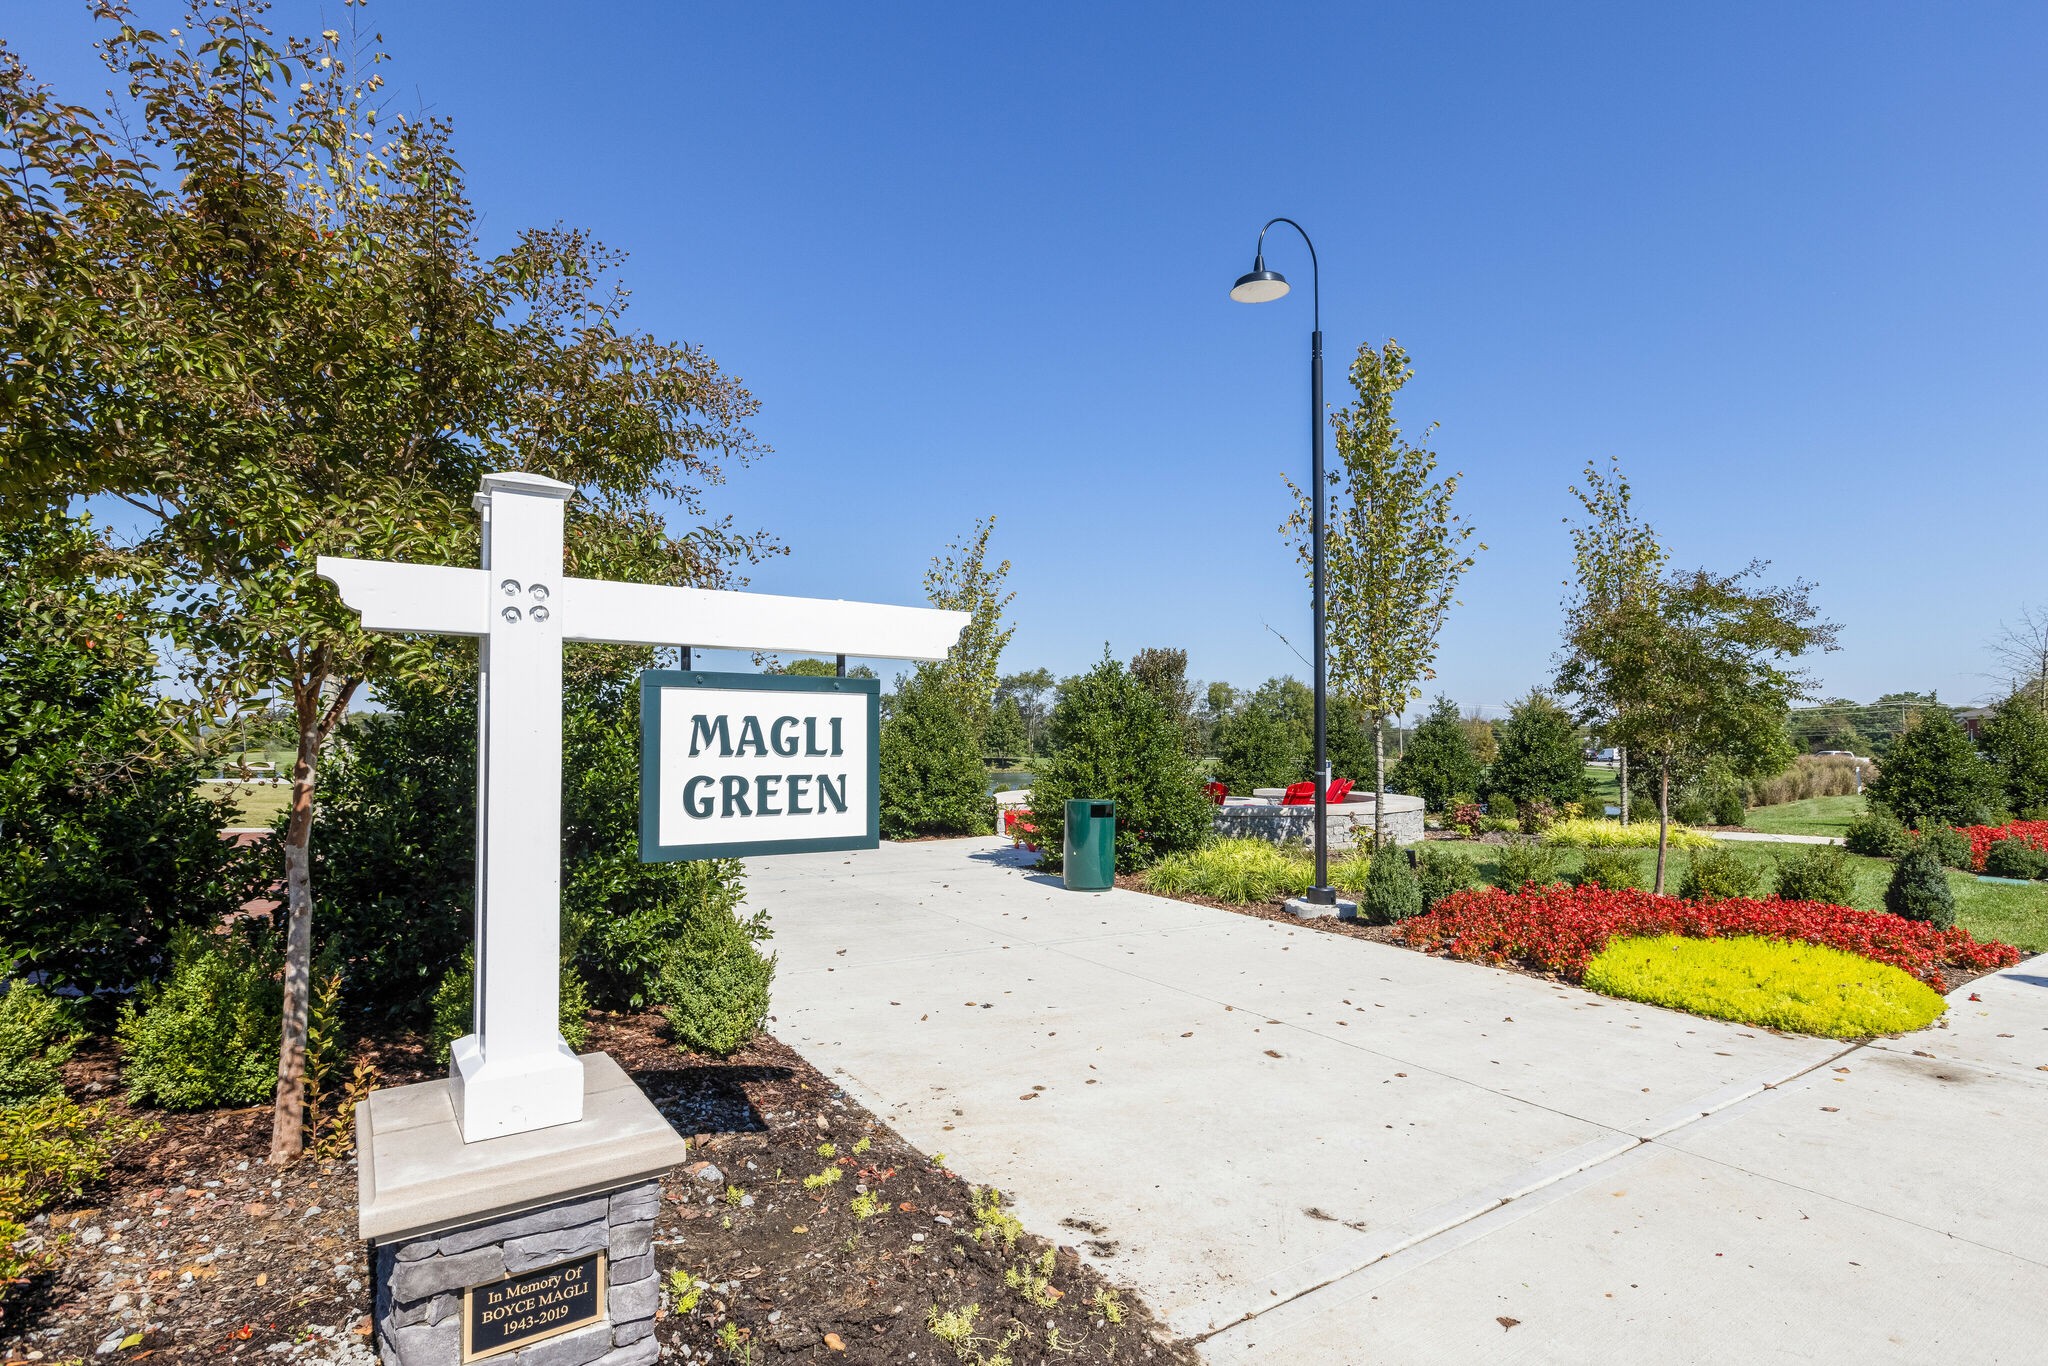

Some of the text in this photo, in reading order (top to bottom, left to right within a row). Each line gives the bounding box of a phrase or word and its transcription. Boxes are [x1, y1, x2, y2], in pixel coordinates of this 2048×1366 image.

[688, 714, 844, 758] MAGLI
[682, 774, 848, 820] GREEN
[481, 1282, 588, 1324] BOYCE MAGLI
[488, 1266, 583, 1305] In Memory Of
[503, 1305, 569, 1335] 1943-2019
